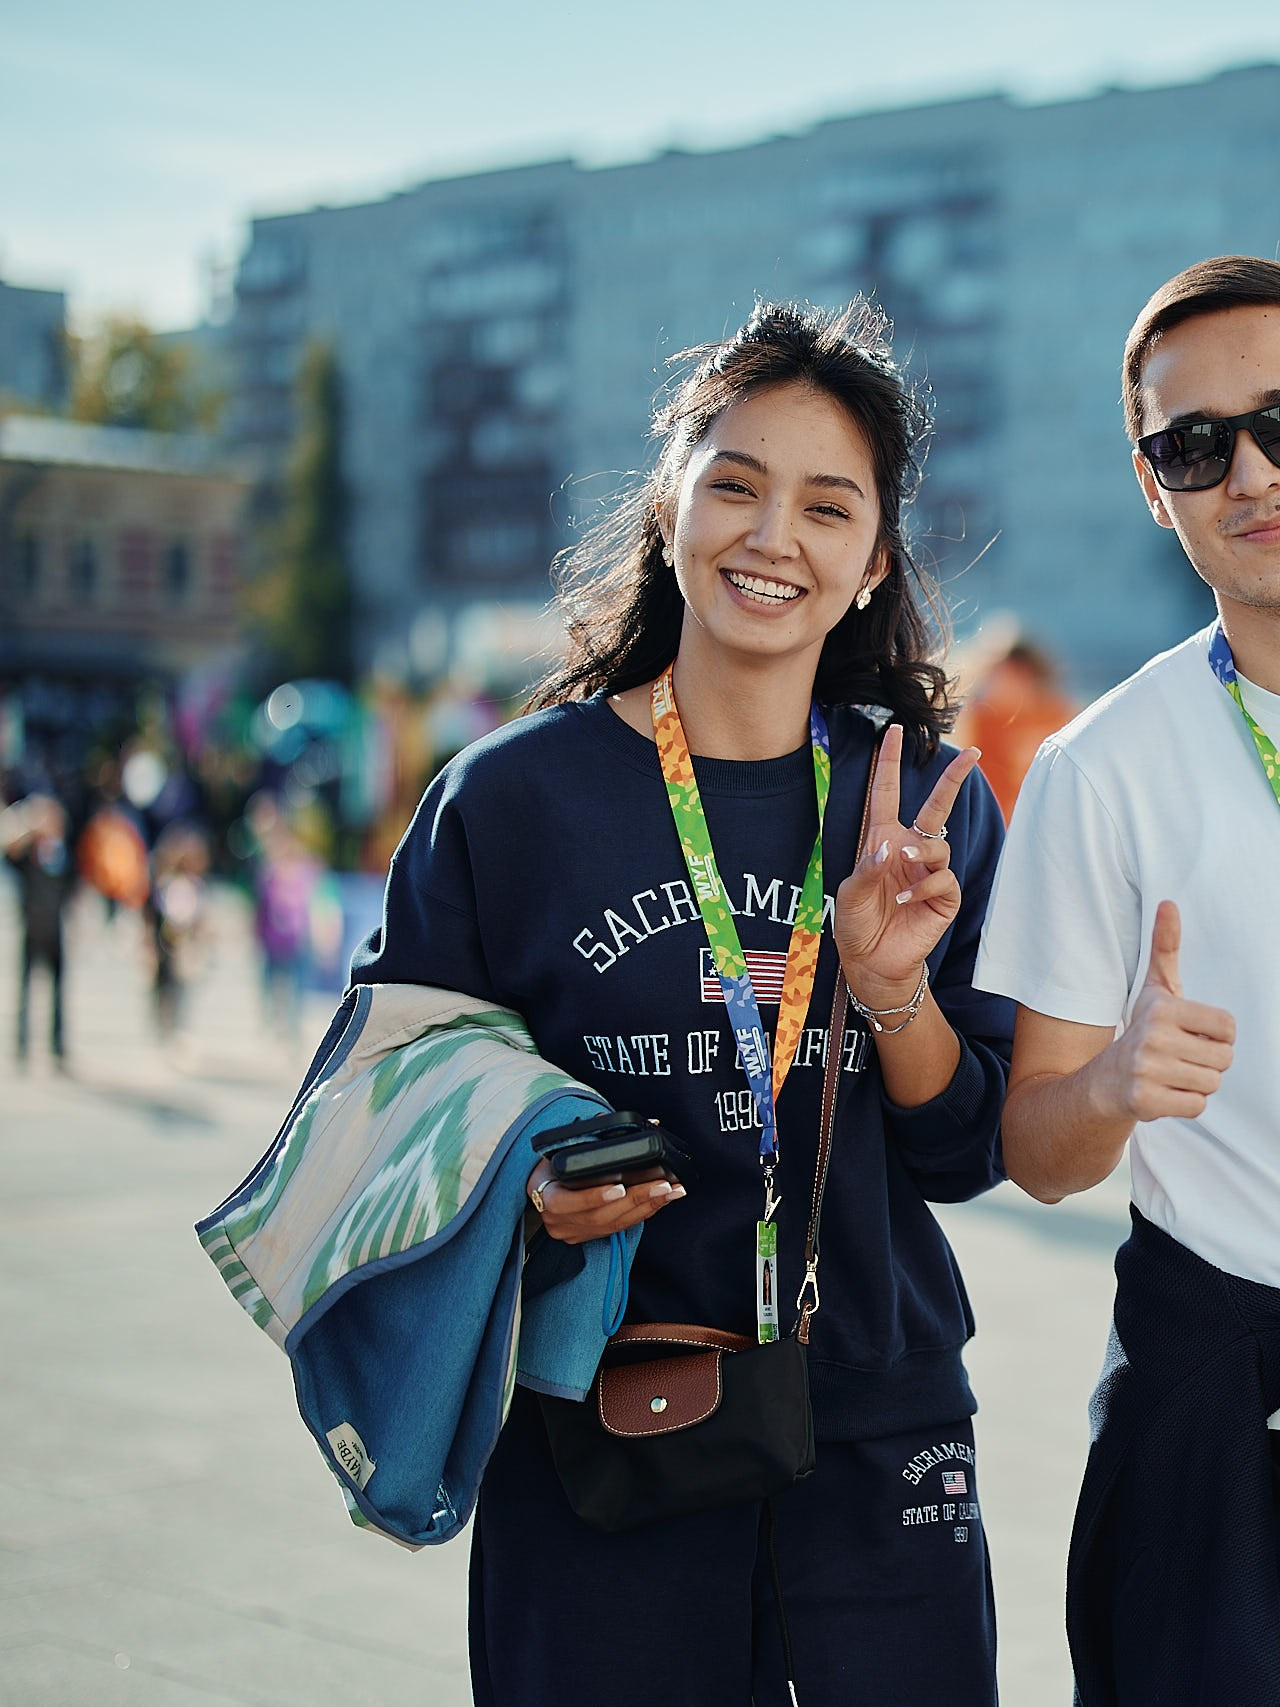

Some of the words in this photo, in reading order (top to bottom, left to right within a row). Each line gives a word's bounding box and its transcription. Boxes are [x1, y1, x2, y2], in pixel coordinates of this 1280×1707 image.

[653, 681, 666, 719] WYF
[688, 856, 713, 902] WYF
[584, 1034, 671, 1075] STATE
[687, 1031, 720, 1073] OF
[736, 1029, 761, 1077] WYF
[902, 1505, 939, 1526] STATE
[943, 1503, 955, 1521] OF
